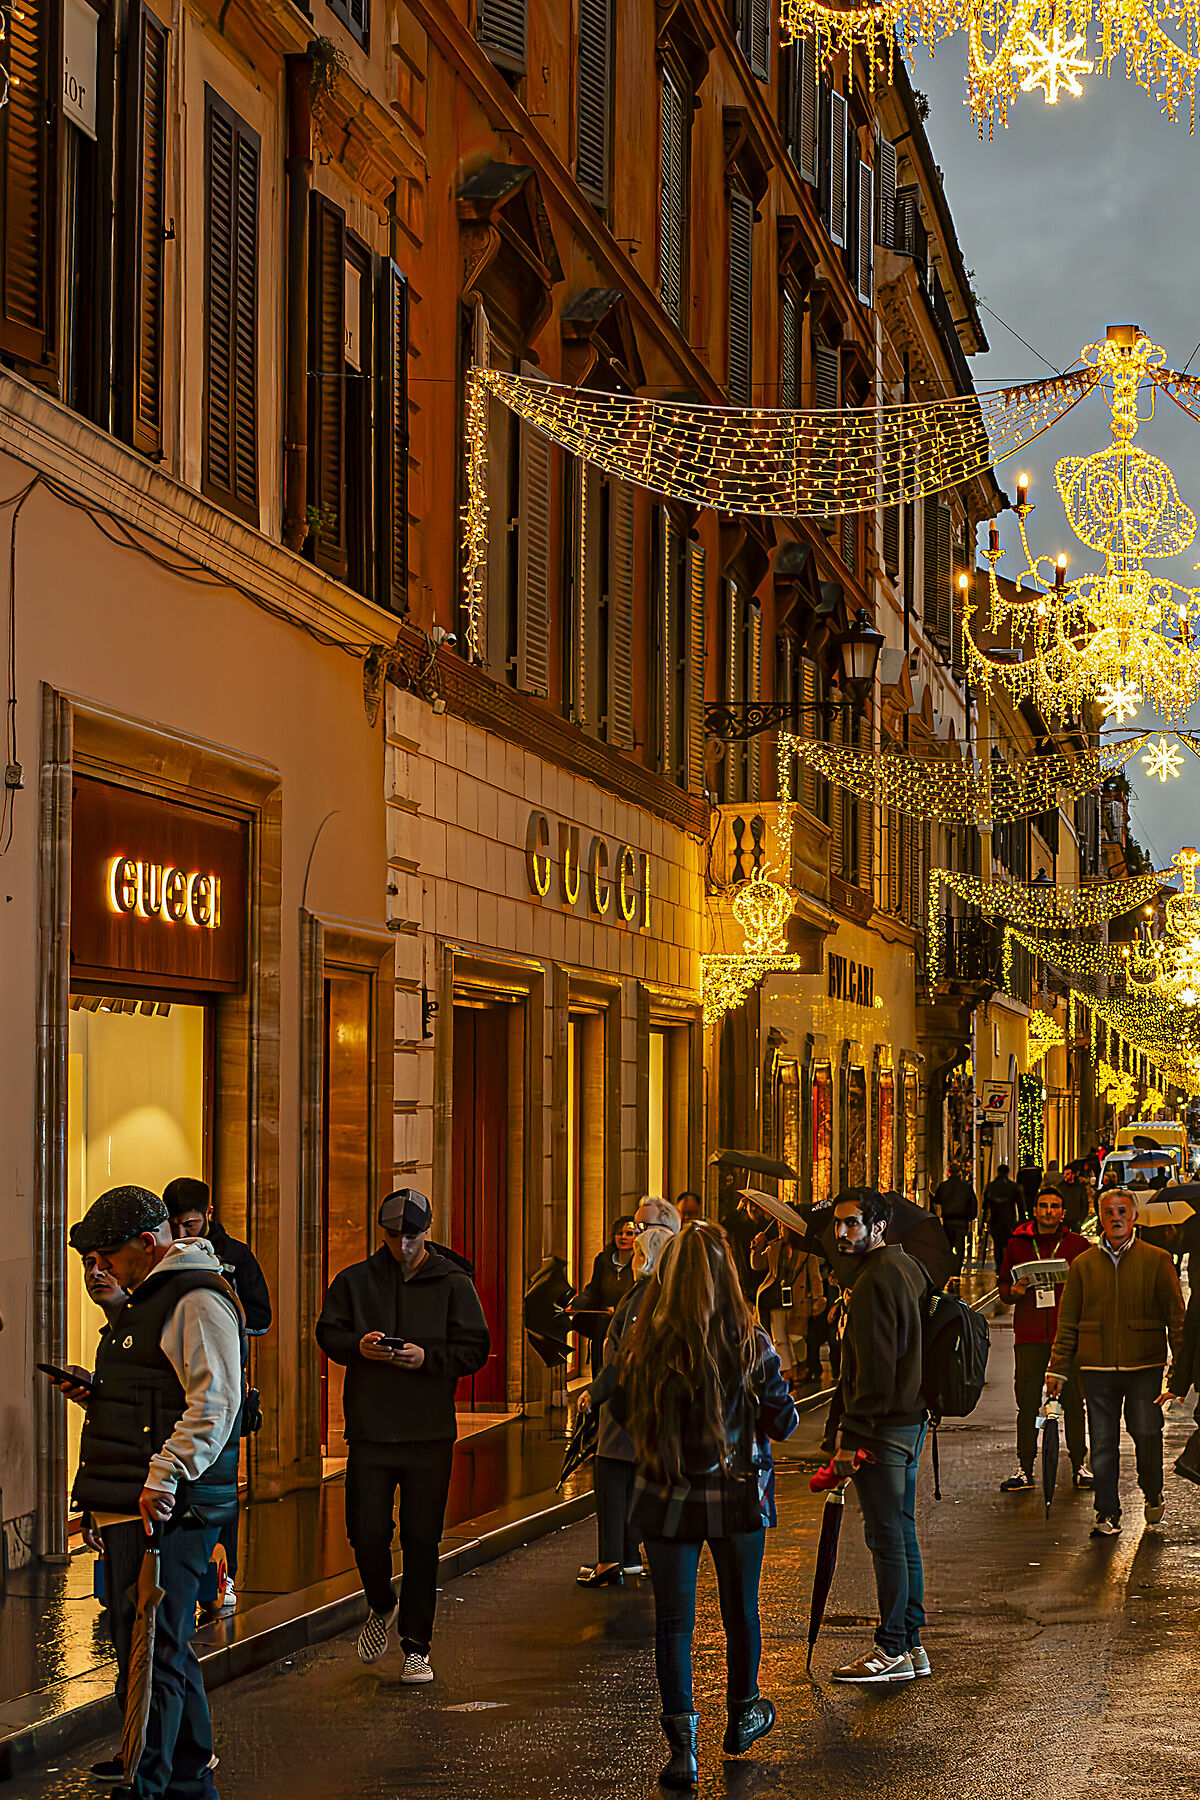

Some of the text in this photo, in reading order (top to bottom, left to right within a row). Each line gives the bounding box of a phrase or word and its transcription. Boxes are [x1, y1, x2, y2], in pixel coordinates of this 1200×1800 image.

[64, 56, 86, 110] ior
[107, 856, 221, 929] GUCCI
[525, 810, 650, 928] GUCCI
[828, 952, 873, 1008] BVLGARI
